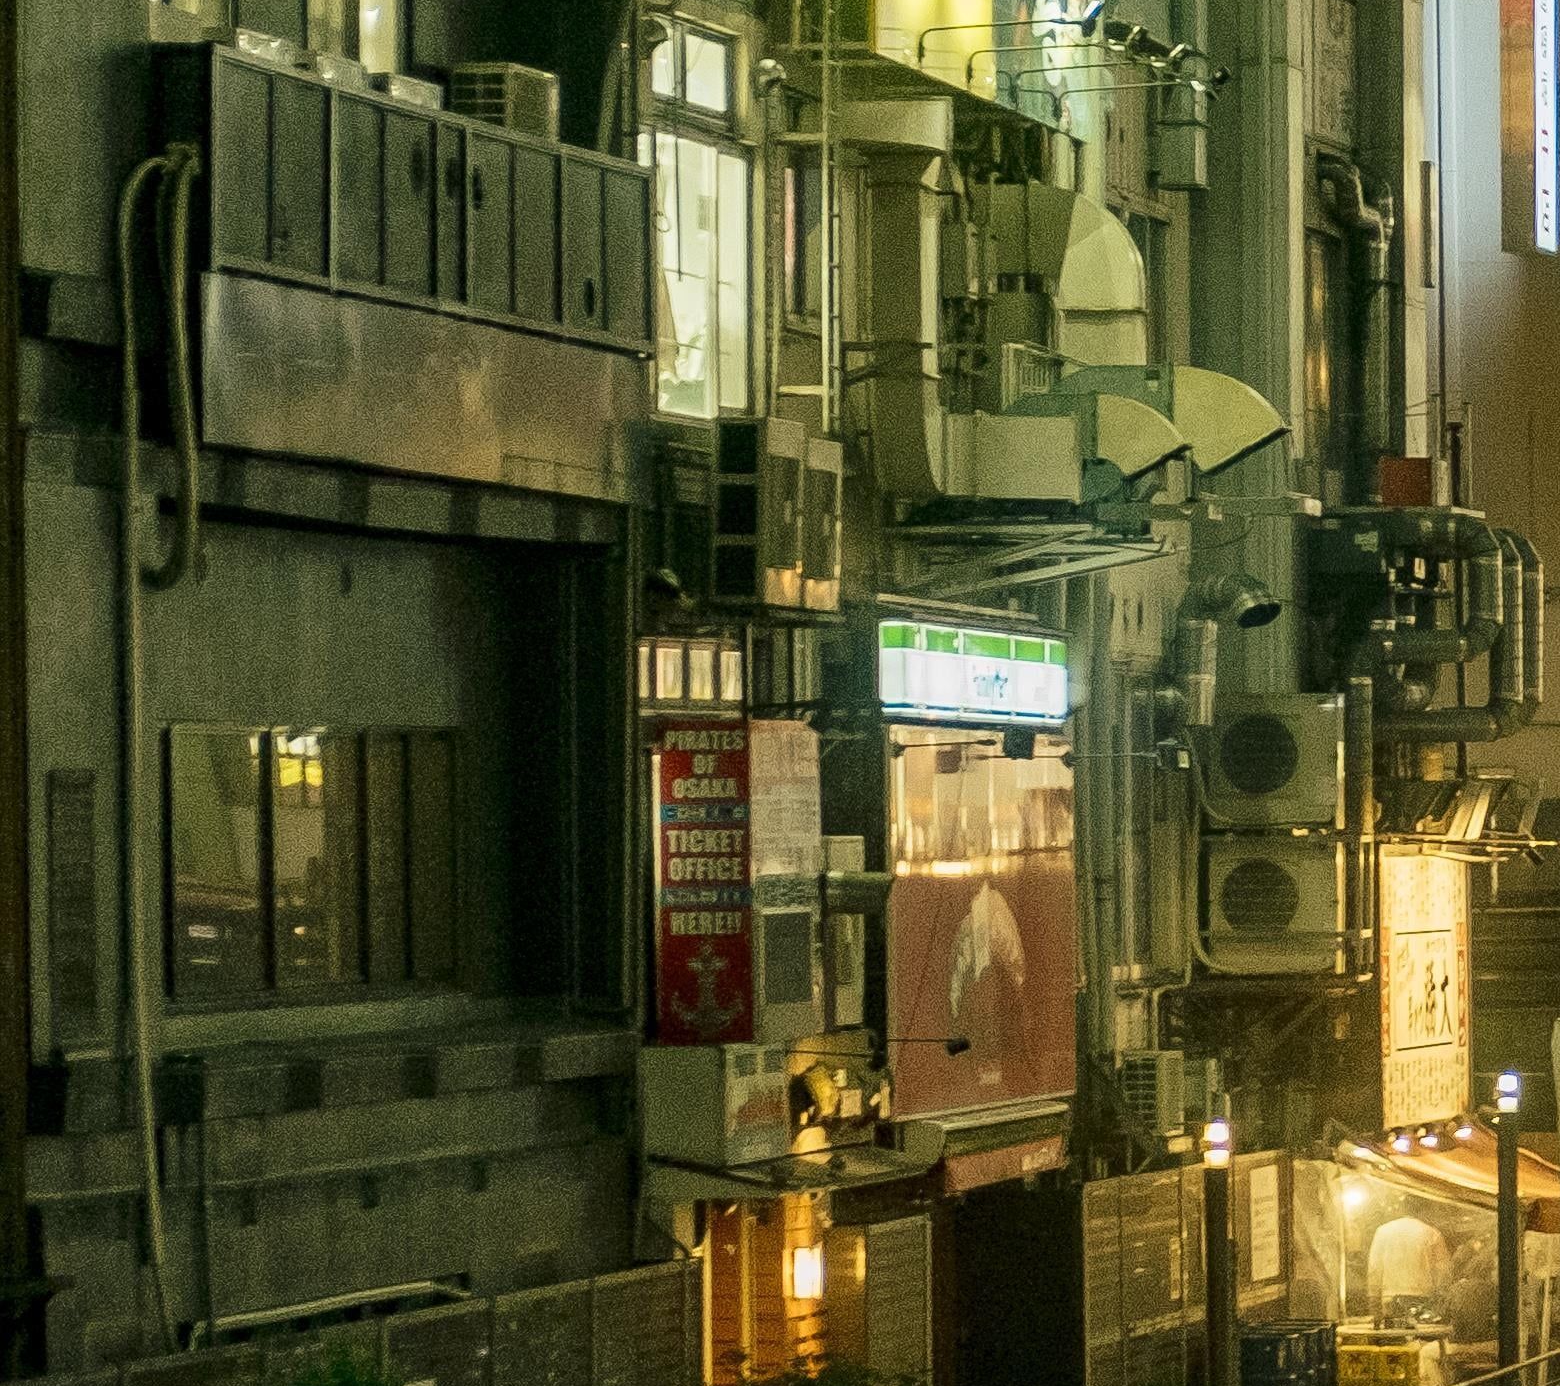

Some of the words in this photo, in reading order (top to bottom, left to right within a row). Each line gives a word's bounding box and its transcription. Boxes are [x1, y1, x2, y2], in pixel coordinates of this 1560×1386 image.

[664, 729, 745, 751] PIRATES
[692, 754, 717, 776] OF
[671, 777, 740, 800] OSAKA
[667, 828, 745, 854] TICKET
[668, 857, 743, 883] OFFICE
